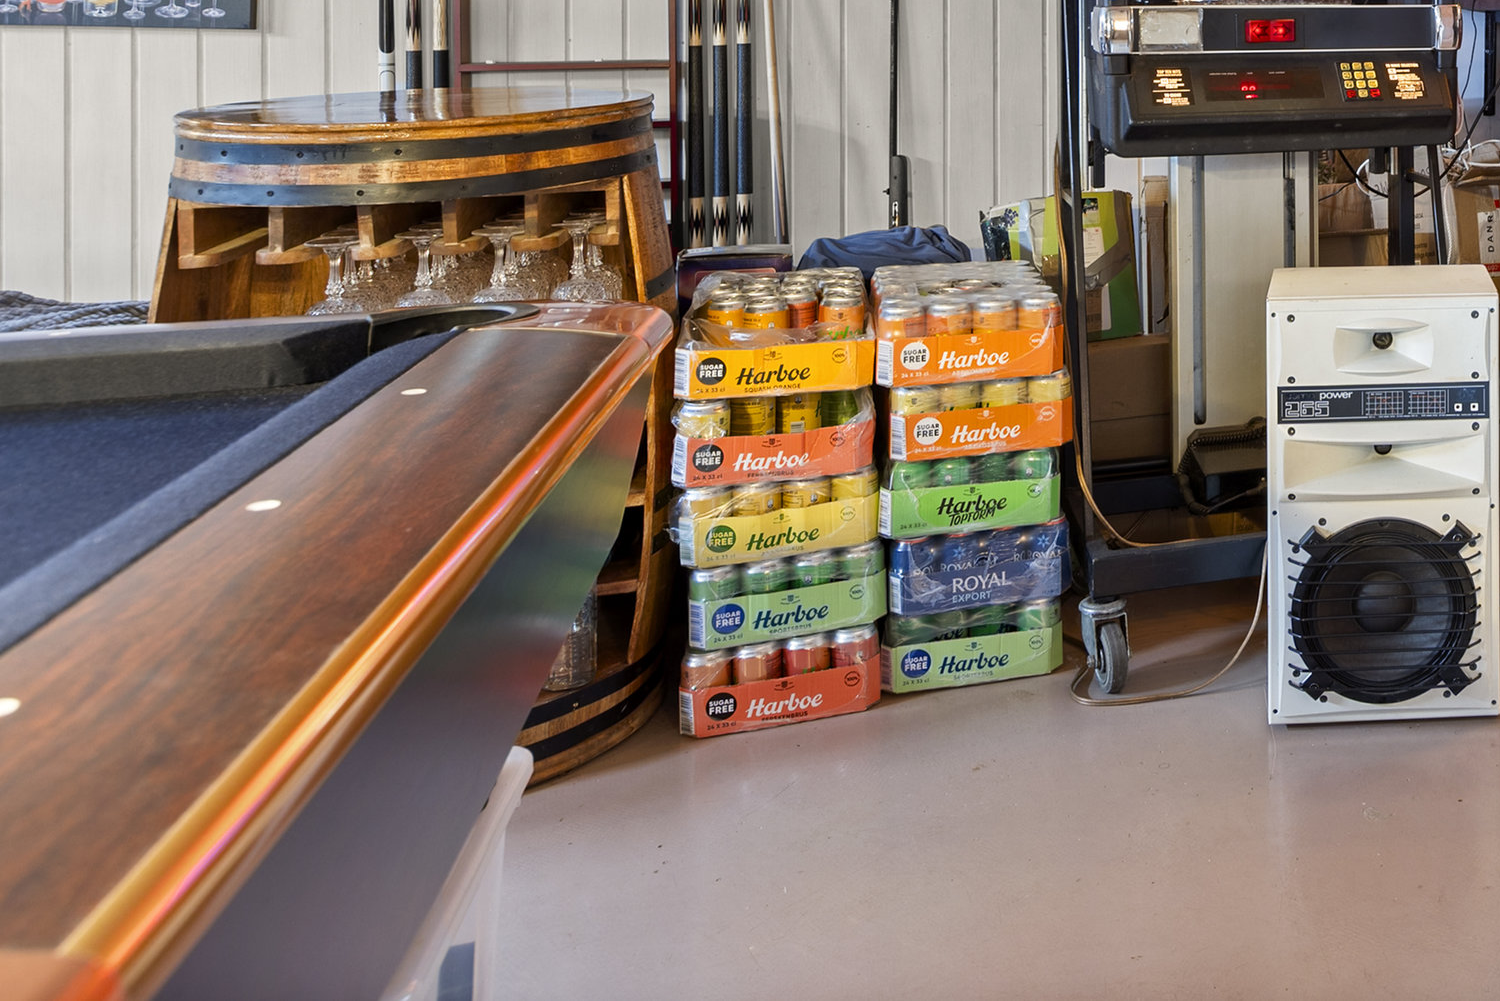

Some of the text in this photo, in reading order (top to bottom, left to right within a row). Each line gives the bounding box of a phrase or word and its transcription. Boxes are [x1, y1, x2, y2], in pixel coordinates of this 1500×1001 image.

[903, 354, 927, 364] FREE
[937, 349, 1010, 370] Harboe
[699, 363, 723, 371] SUGAR
[699, 369, 723, 378] FREE
[735, 364, 811, 385] Harboe
[1319, 390, 1353, 400] power
[1285, 401, 1330, 418] 265
[916, 429, 939, 438] FREE
[951, 422, 1021, 444] Harboe
[695, 451, 722, 459] SUGAR
[695, 457, 722, 466] FREE
[733, 450, 810, 472] Harboe
[936, 495, 1008, 516] Harboe
[949, 508, 996, 527] TOPFORM
[710, 531, 734, 539] SUGAR
[747, 526, 819, 551] Harboe
[708, 537, 734, 547] FREE
[952, 570, 1012, 593] ROYAL
[952, 590, 992, 604] EXPORT
[715, 610, 741, 619] SUGAR
[752, 604, 829, 630] Harboe
[715, 617, 741, 628] FREE
[904, 655, 928, 664] SUGAR
[938, 652, 1009, 675] Harboe
[904, 662, 928, 672] FREE
[708, 698, 734, 707] SUGAR
[746, 693, 823, 718] Harboe
[708, 705, 734, 715] FREE
